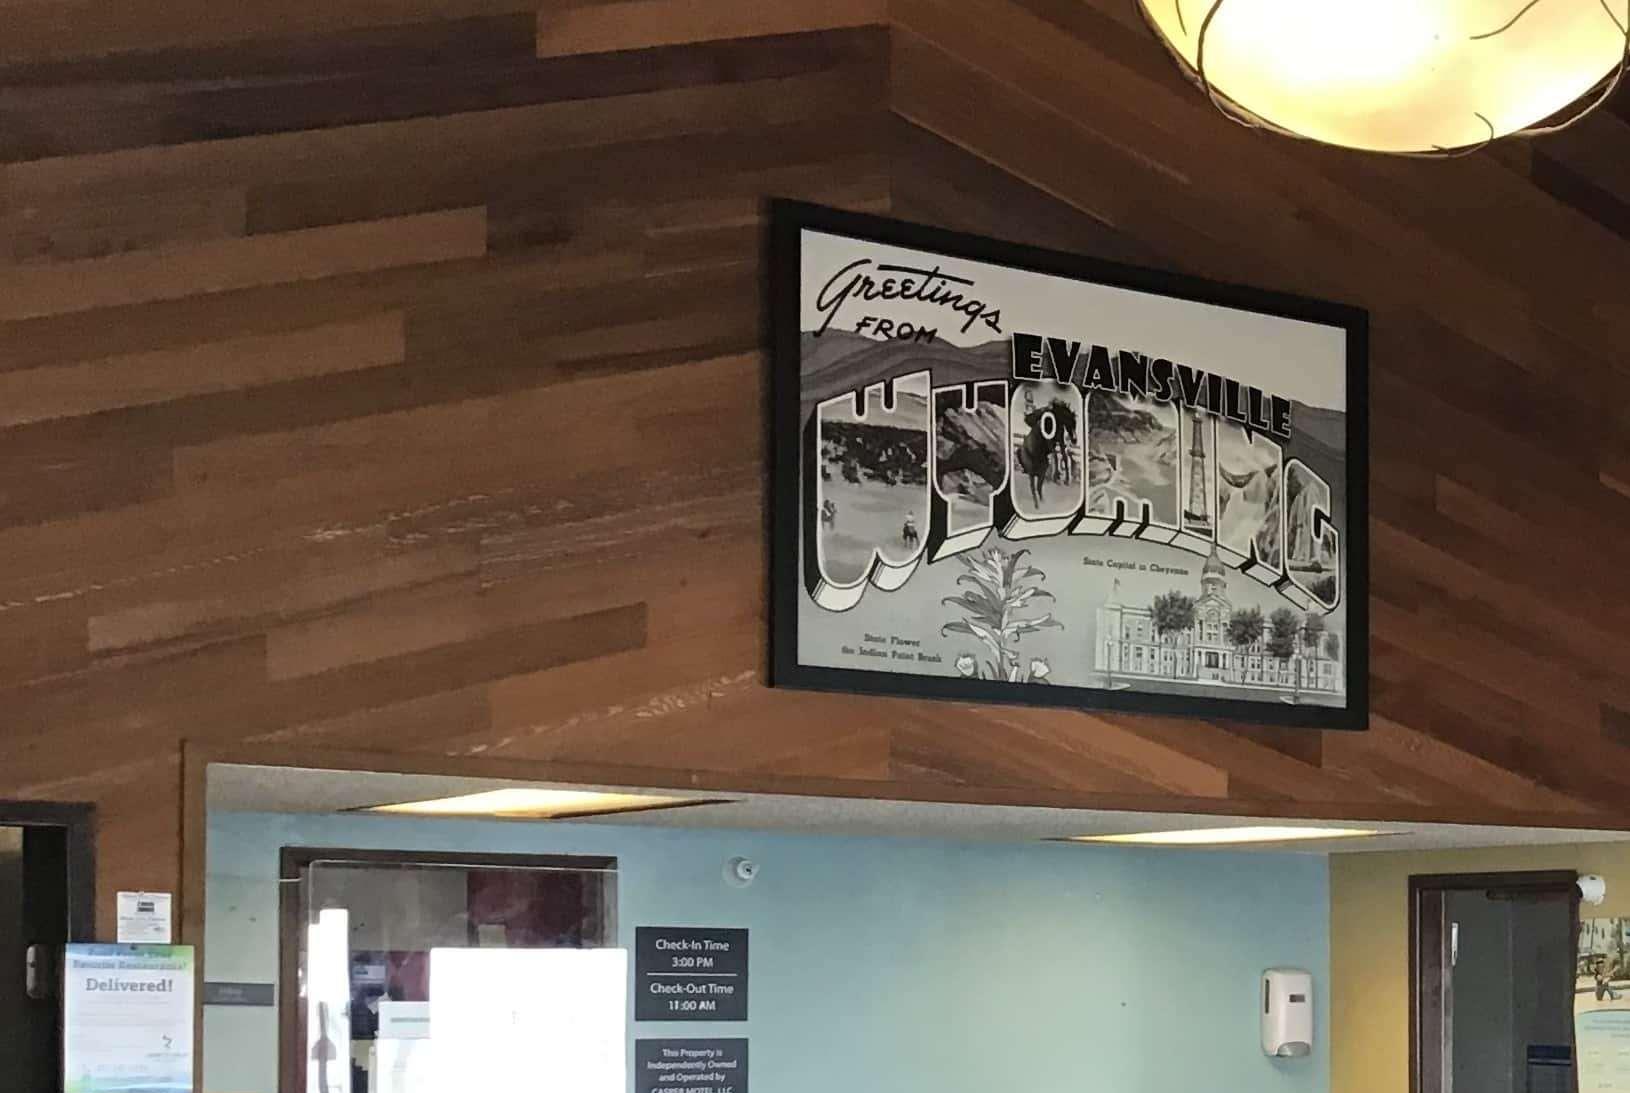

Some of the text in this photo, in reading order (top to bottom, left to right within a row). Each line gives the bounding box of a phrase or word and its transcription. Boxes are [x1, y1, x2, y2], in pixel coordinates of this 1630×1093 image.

[813, 258, 1002, 338] Greetings
[854, 316, 938, 344] FROM
[1011, 331, 1292, 440] EVANSVILLE
[804, 368, 1342, 613] WYOMING
[655, 939, 730, 951] Check-In Time
[672, 957, 714, 967] 3:00 PM
[86, 977, 173, 993] Delivered!
[650, 983, 734, 994] Check-Out Time
[669, 1000, 716, 1011] 11:00 AM
[680, 1048, 714, 1058] Property
[647, 1060, 737, 1070] Independently Owned
[658, 1073, 726, 1083] and Operated by
